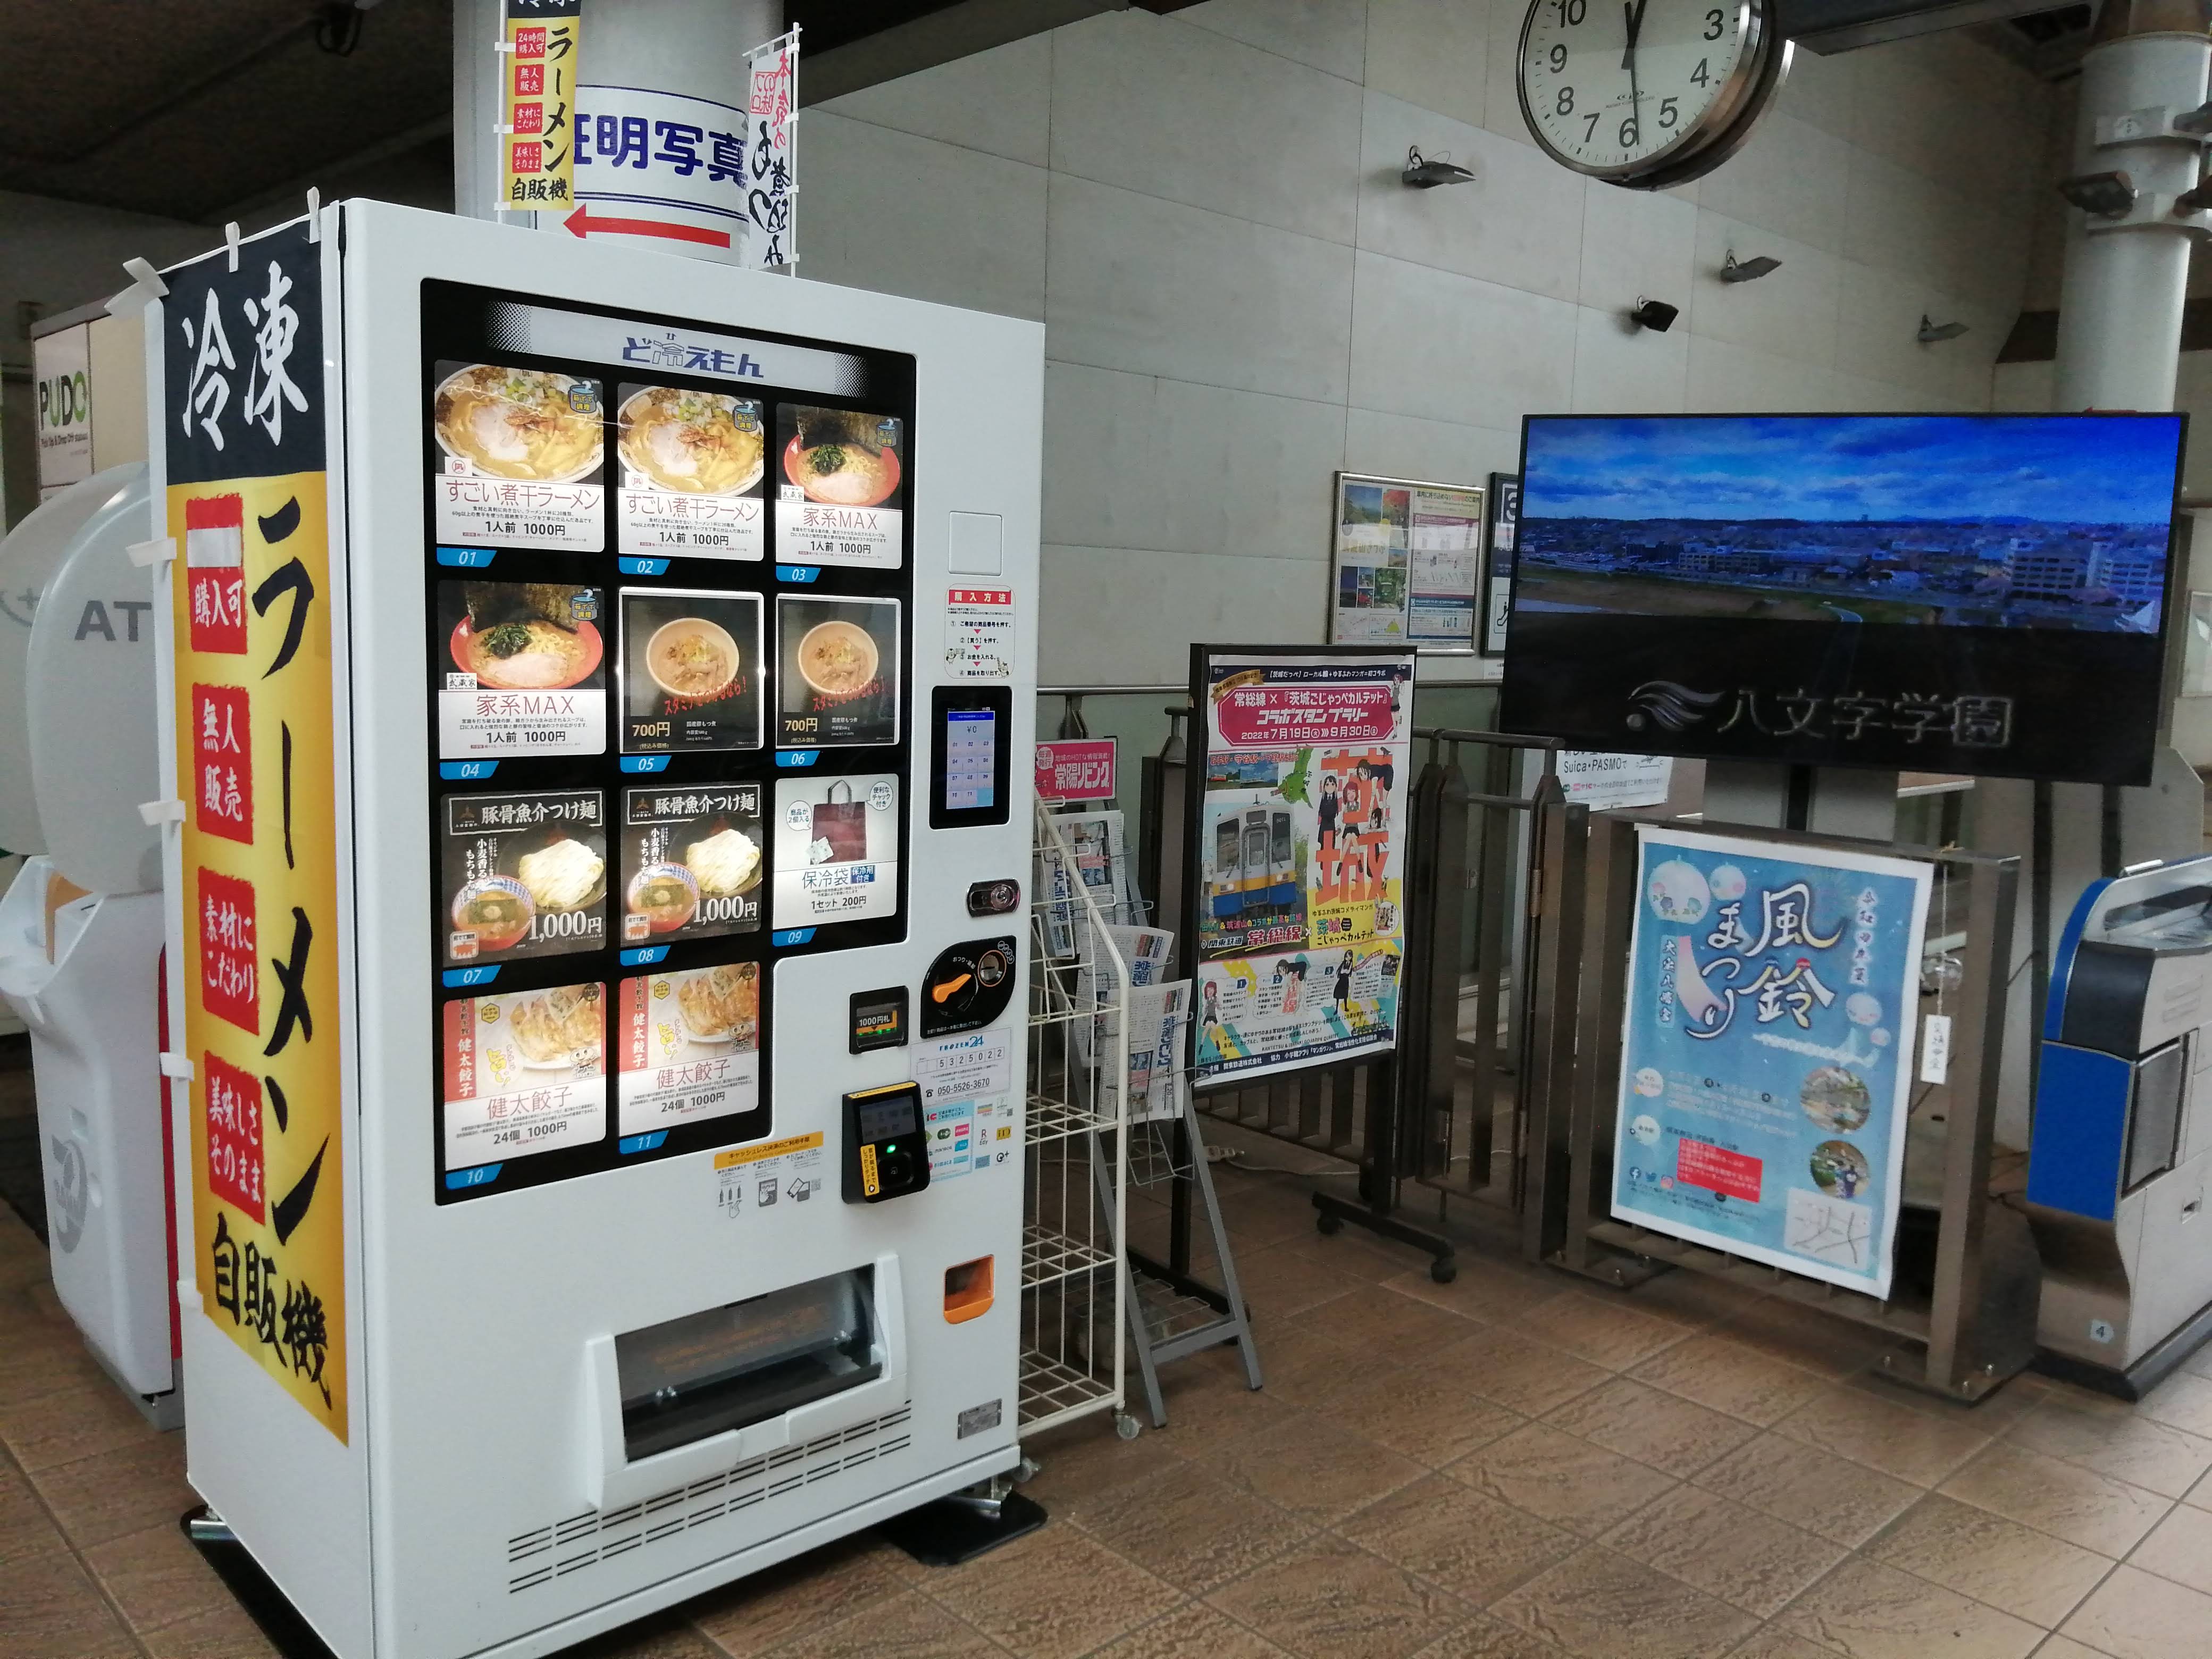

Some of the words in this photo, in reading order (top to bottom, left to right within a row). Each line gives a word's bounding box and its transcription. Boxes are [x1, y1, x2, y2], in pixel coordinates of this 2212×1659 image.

[1557, 0, 1586, 28] 10
[1704, 9, 1724, 40] 3
[518, 31, 544, 43] 24時間
[1550, 44, 1568, 73] 9
[520, 68, 539, 79] 無人
[1690, 58, 1710, 88] 4
[520, 80, 539, 91] 販売
[542, 27, 573, 172] ラーメン
[1556, 87, 1574, 116] 8
[517, 107, 541, 118] 素材に
[1658, 96, 1679, 128] 5
[517, 119, 540, 129] こだわり
[1583, 113, 1601, 143] 7
[1619, 118, 1638, 148] 6
[515, 147, 539, 158] 美味しさ
[515, 158, 539, 169] そのまま
[512, 178, 568, 201] 自販機
[182, 259, 309, 451] 冷凍
[622, 336, 764, 378] ど冷えもん
[39, 370, 86, 431] PUDO
[446, 480, 600, 510] すごい煮干ラーメン
[626, 493, 759, 521] すごい煮干ラーメン
[485, 521, 516, 533] 1人前
[524, 523, 566, 536] 1000円
[803, 507, 877, 530] 家系MAX
[659, 532, 686, 543] 1人前
[693, 533, 729, 546] 1000円
[811, 541, 834, 552] 1人前
[840, 543, 871, 554] 1000円
[458, 551, 476, 565] 01
[637, 560, 653, 573] 02
[792, 568, 806, 581] 03
[195, 578, 241, 628] 購入可
[954, 592, 1006, 602] 購入方法
[476, 694, 574, 716] 家系MAX
[1234, 692, 1266, 707] 常総線
[203, 699, 240, 753] 無人
[785, 717, 818, 732] 700円
[1256, 708, 1369, 725] コラボスタンプラリー
[1717, 686, 2013, 747] 八文字学園
[487, 731, 517, 743] 1人前
[524, 731, 566, 742] 1000円
[632, 722, 671, 737] 700円
[638, 758, 654, 770] 05
[791, 753, 805, 765] 06
[461, 764, 480, 777] 04
[1055, 761, 1109, 790] 常陽リビング
[204, 764, 243, 822] 販売
[655, 793, 755, 815] 豚骨魚介つけ麺
[481, 800, 597, 825] 豚骨魚介つけ麺
[252, 496, 331, 1245] ラーメン
[802, 868, 849, 889] 保冷袋
[852, 866, 874, 876] 保冷剤
[693, 896, 757, 925] 1,000円
[811, 899, 837, 910] 1セット
[842, 895, 867, 907] 200円
[204, 895, 254, 950] 素材に
[529, 911, 602, 943] 1,000円
[787, 932, 802, 943] 09
[1208, 936, 1243, 948] 関東鉄道
[1248, 925, 1302, 946] 常総線
[1317, 929, 1374, 945] ごじゃっぺカルテット
[638, 949, 654, 962] 08
[1737, 883, 1845, 1028] 風鈴
[205, 951, 255, 1005] こだわり
[463, 969, 481, 983] 07
[859, 1015, 890, 1027] 1000円札
[633, 1013, 646, 1068] 健太餃子
[458, 1038, 474, 1096] 健太餃子
[657, 1058, 731, 1090] 健太餃子
[937, 1077, 990, 1095] 050-5526-3670
[209, 1078, 258, 1145] 美味しさ
[487, 1086, 572, 1120] 健太餃子
[661, 1099, 684, 1112] 24個
[691, 1092, 725, 1107] 1000円
[493, 1129, 520, 1145] 24個
[527, 1121, 567, 1137] 1000円
[638, 1135, 651, 1149] 11
[210, 1134, 261, 1203] そのまま
[467, 1169, 484, 1184] 10
[212, 1212, 333, 1412] 自販機
[2096, 1325, 2105, 1338] 4
